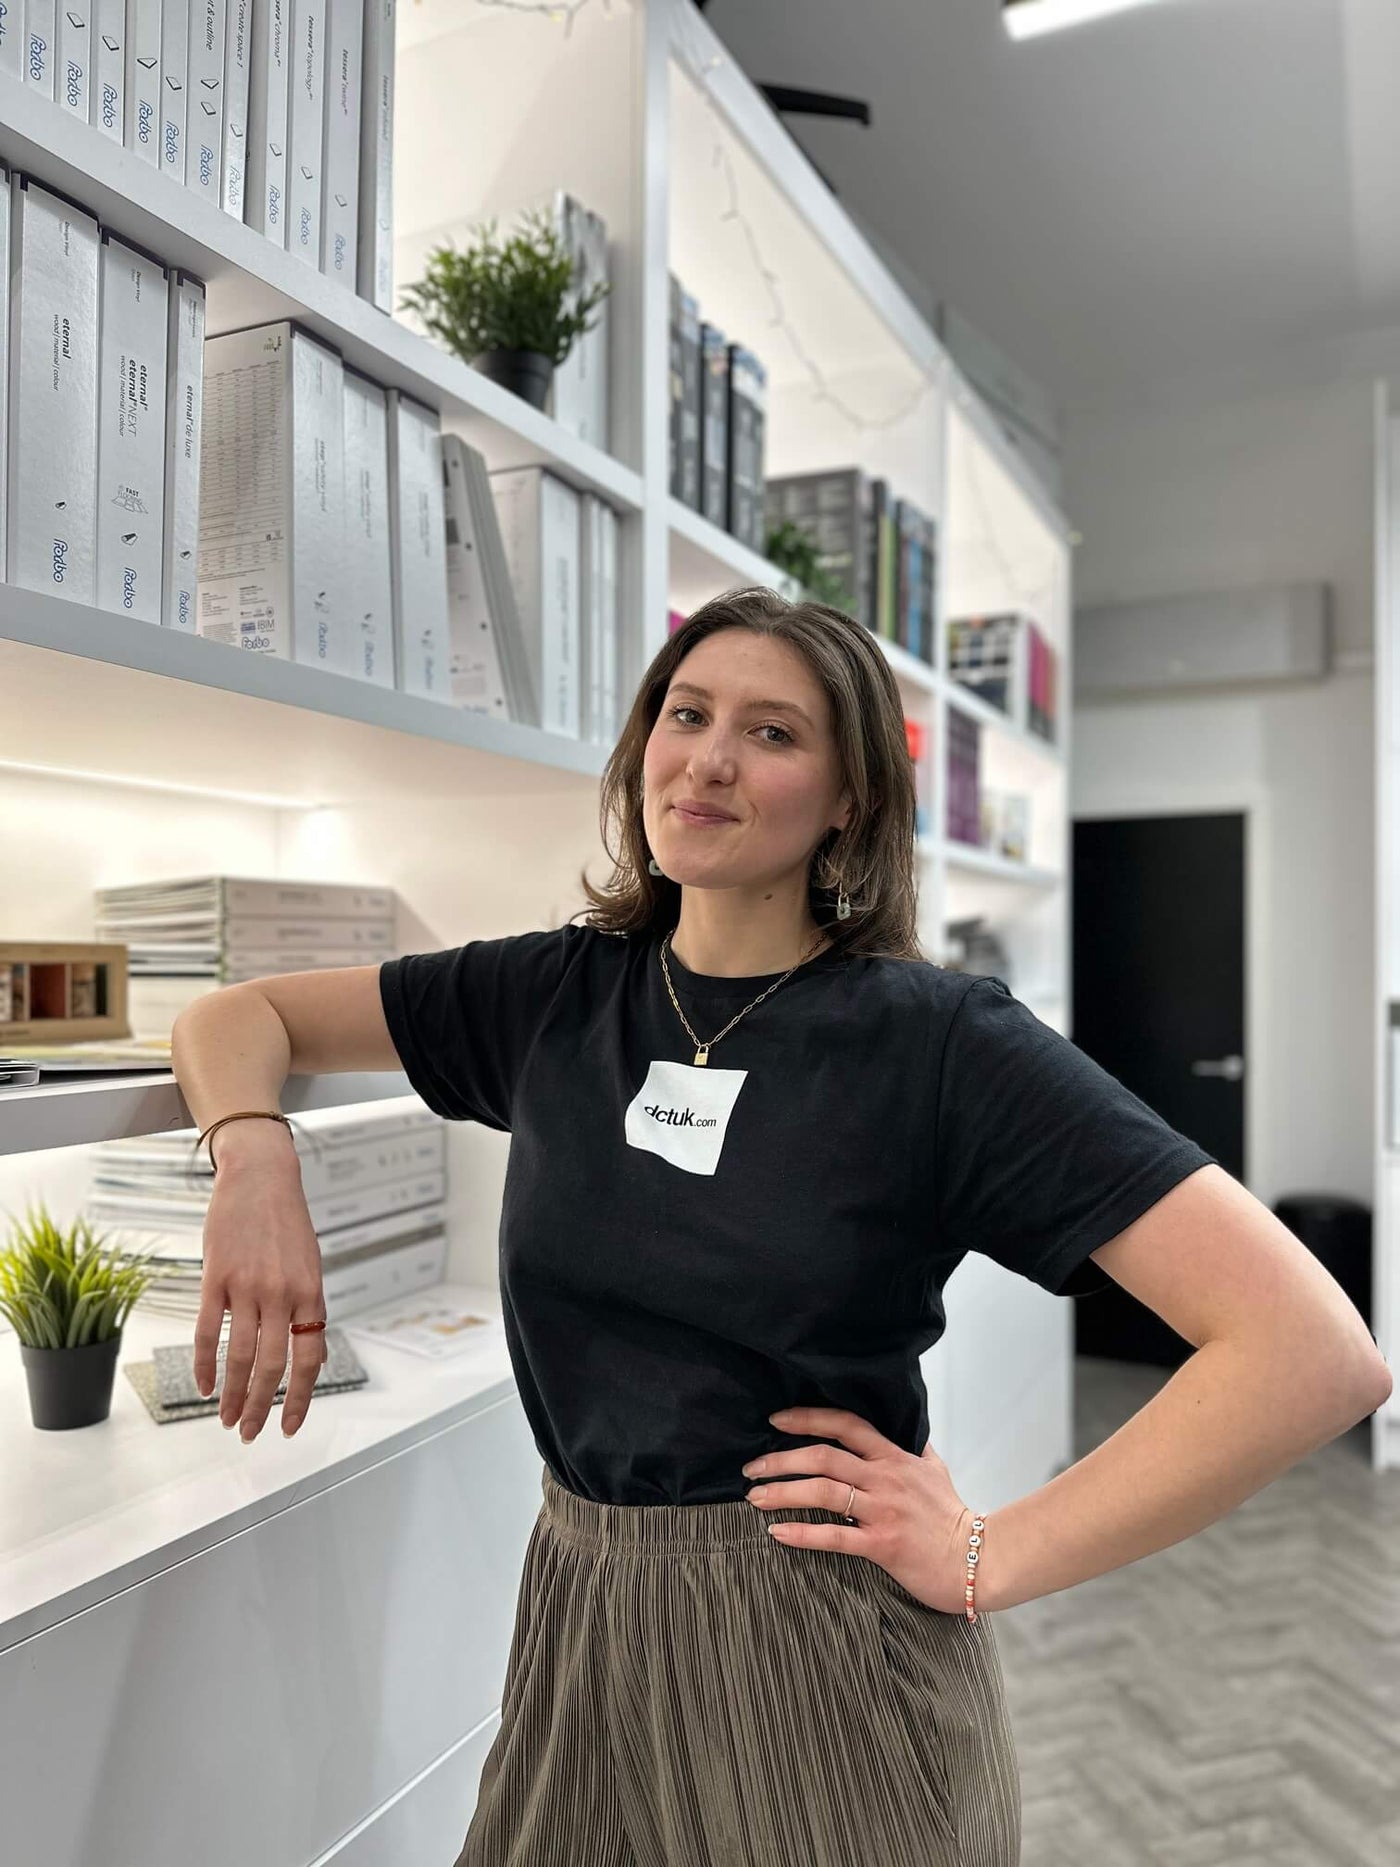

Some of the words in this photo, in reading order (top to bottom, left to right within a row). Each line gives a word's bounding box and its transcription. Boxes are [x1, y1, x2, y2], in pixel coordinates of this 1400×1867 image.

[206, 16, 215, 51] outline
[62, 318, 72, 360] eternal
[644, 1105, 717, 1127] dctuk.com
